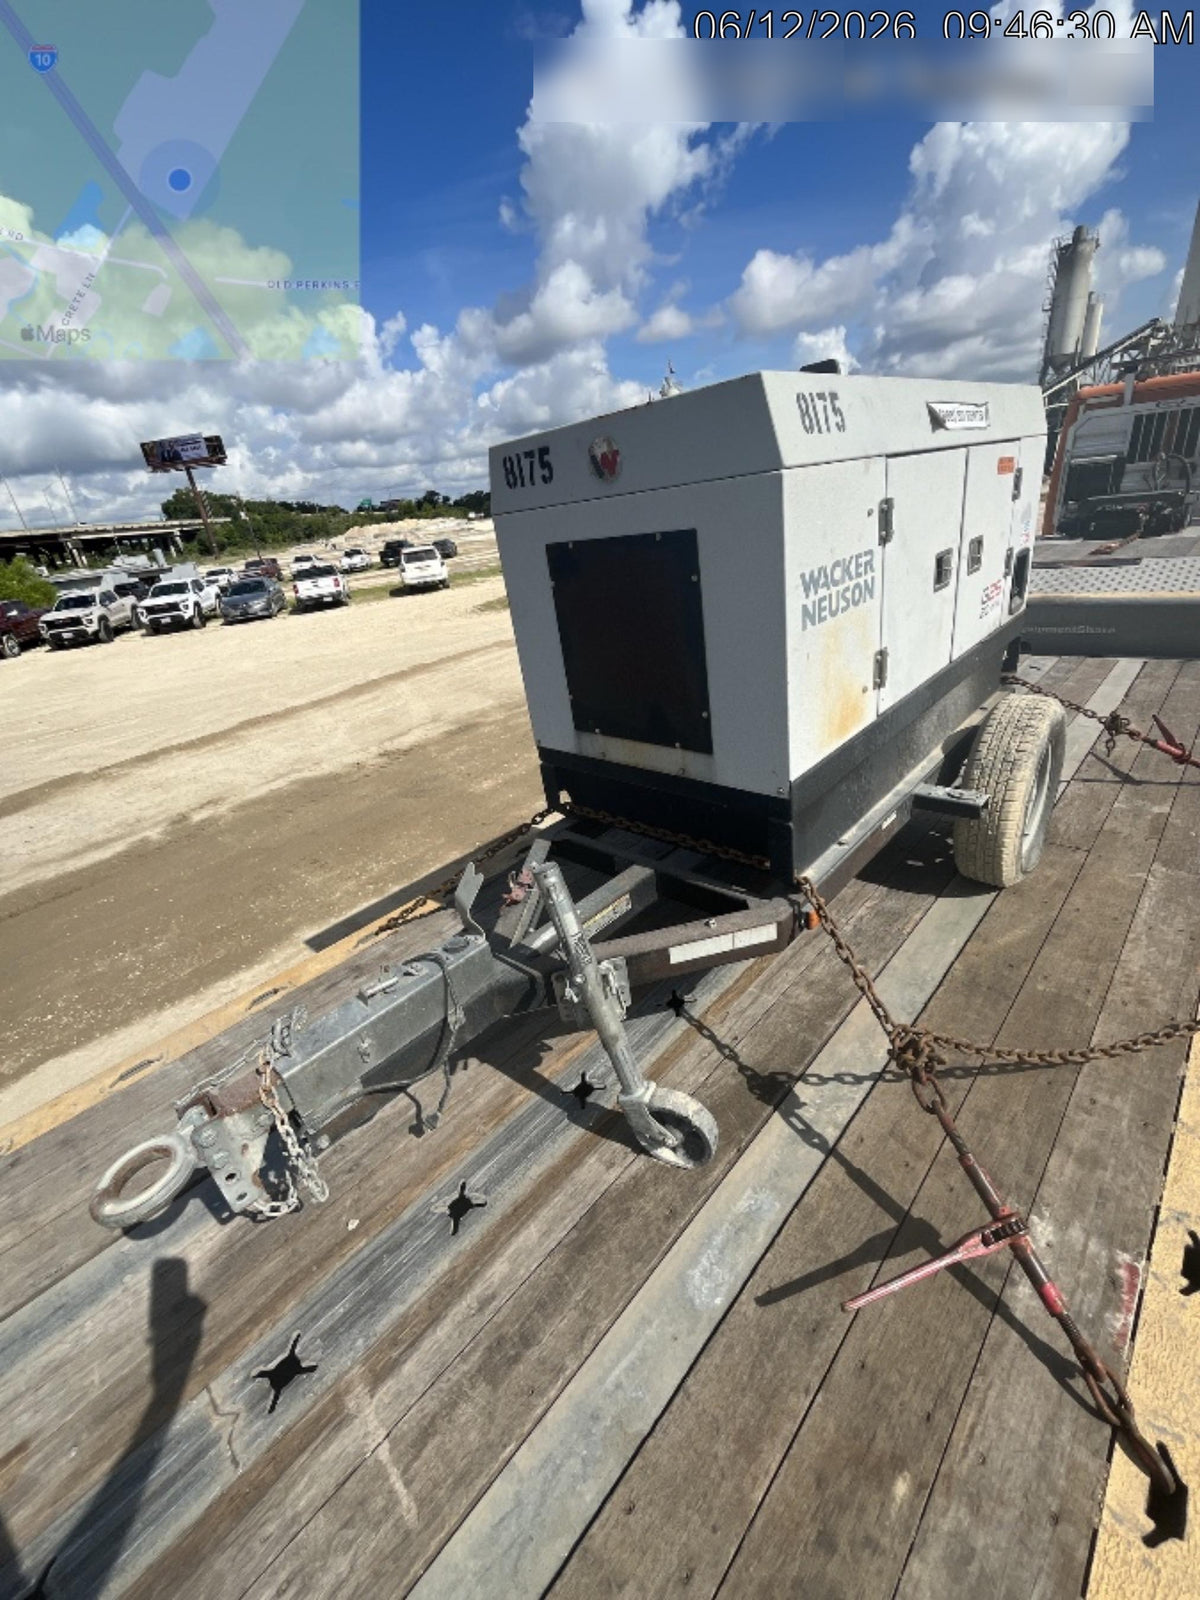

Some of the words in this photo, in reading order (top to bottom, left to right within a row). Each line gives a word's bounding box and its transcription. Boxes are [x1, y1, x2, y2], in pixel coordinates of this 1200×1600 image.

[796, 391, 846, 434] 8175
[503, 446, 554, 490] 8175
[800, 549, 875, 600] WACKER
[801, 576, 876, 632] NEUSON
